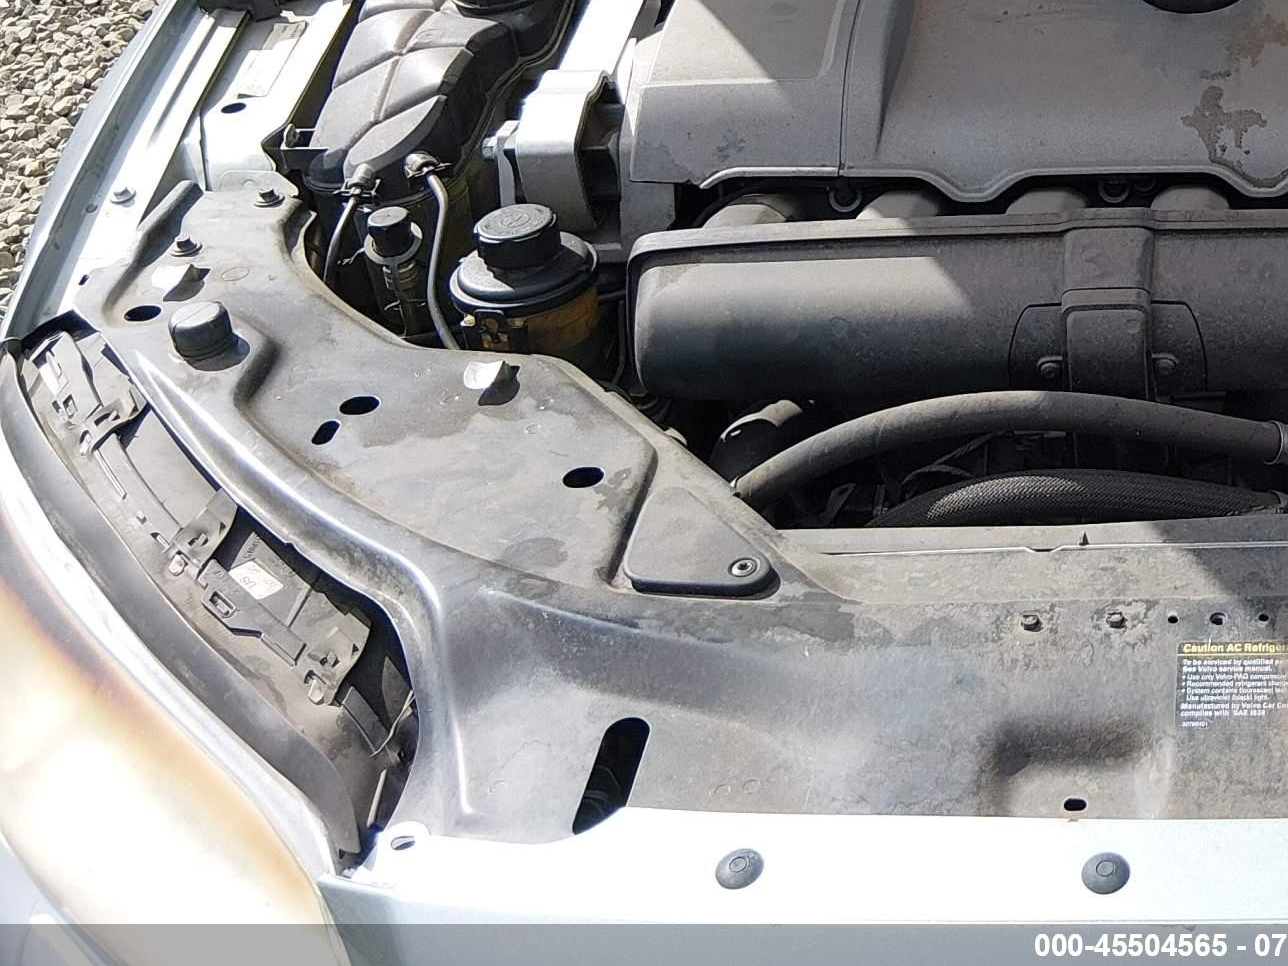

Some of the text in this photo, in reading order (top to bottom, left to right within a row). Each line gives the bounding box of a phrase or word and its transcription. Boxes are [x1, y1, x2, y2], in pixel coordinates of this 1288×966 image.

[1182, 643, 1225, 653] Caution
[1226, 644, 1242, 652] AC
[1182, 658, 1192, 666] To
[1193, 658, 1202, 666] be
[1203, 658, 1232, 666] serviced
[1233, 658, 1241, 667] by
[1243, 658, 1274, 667] qualified
[1201, 673, 1214, 681] only
[1235, 680, 1267, 688] refrigerant
[1186, 687, 1210, 695] System
[1180, 702, 1230, 710] Manufactured
[1231, 702, 1240, 711] by
[1180, 710, 1213, 718] complies
